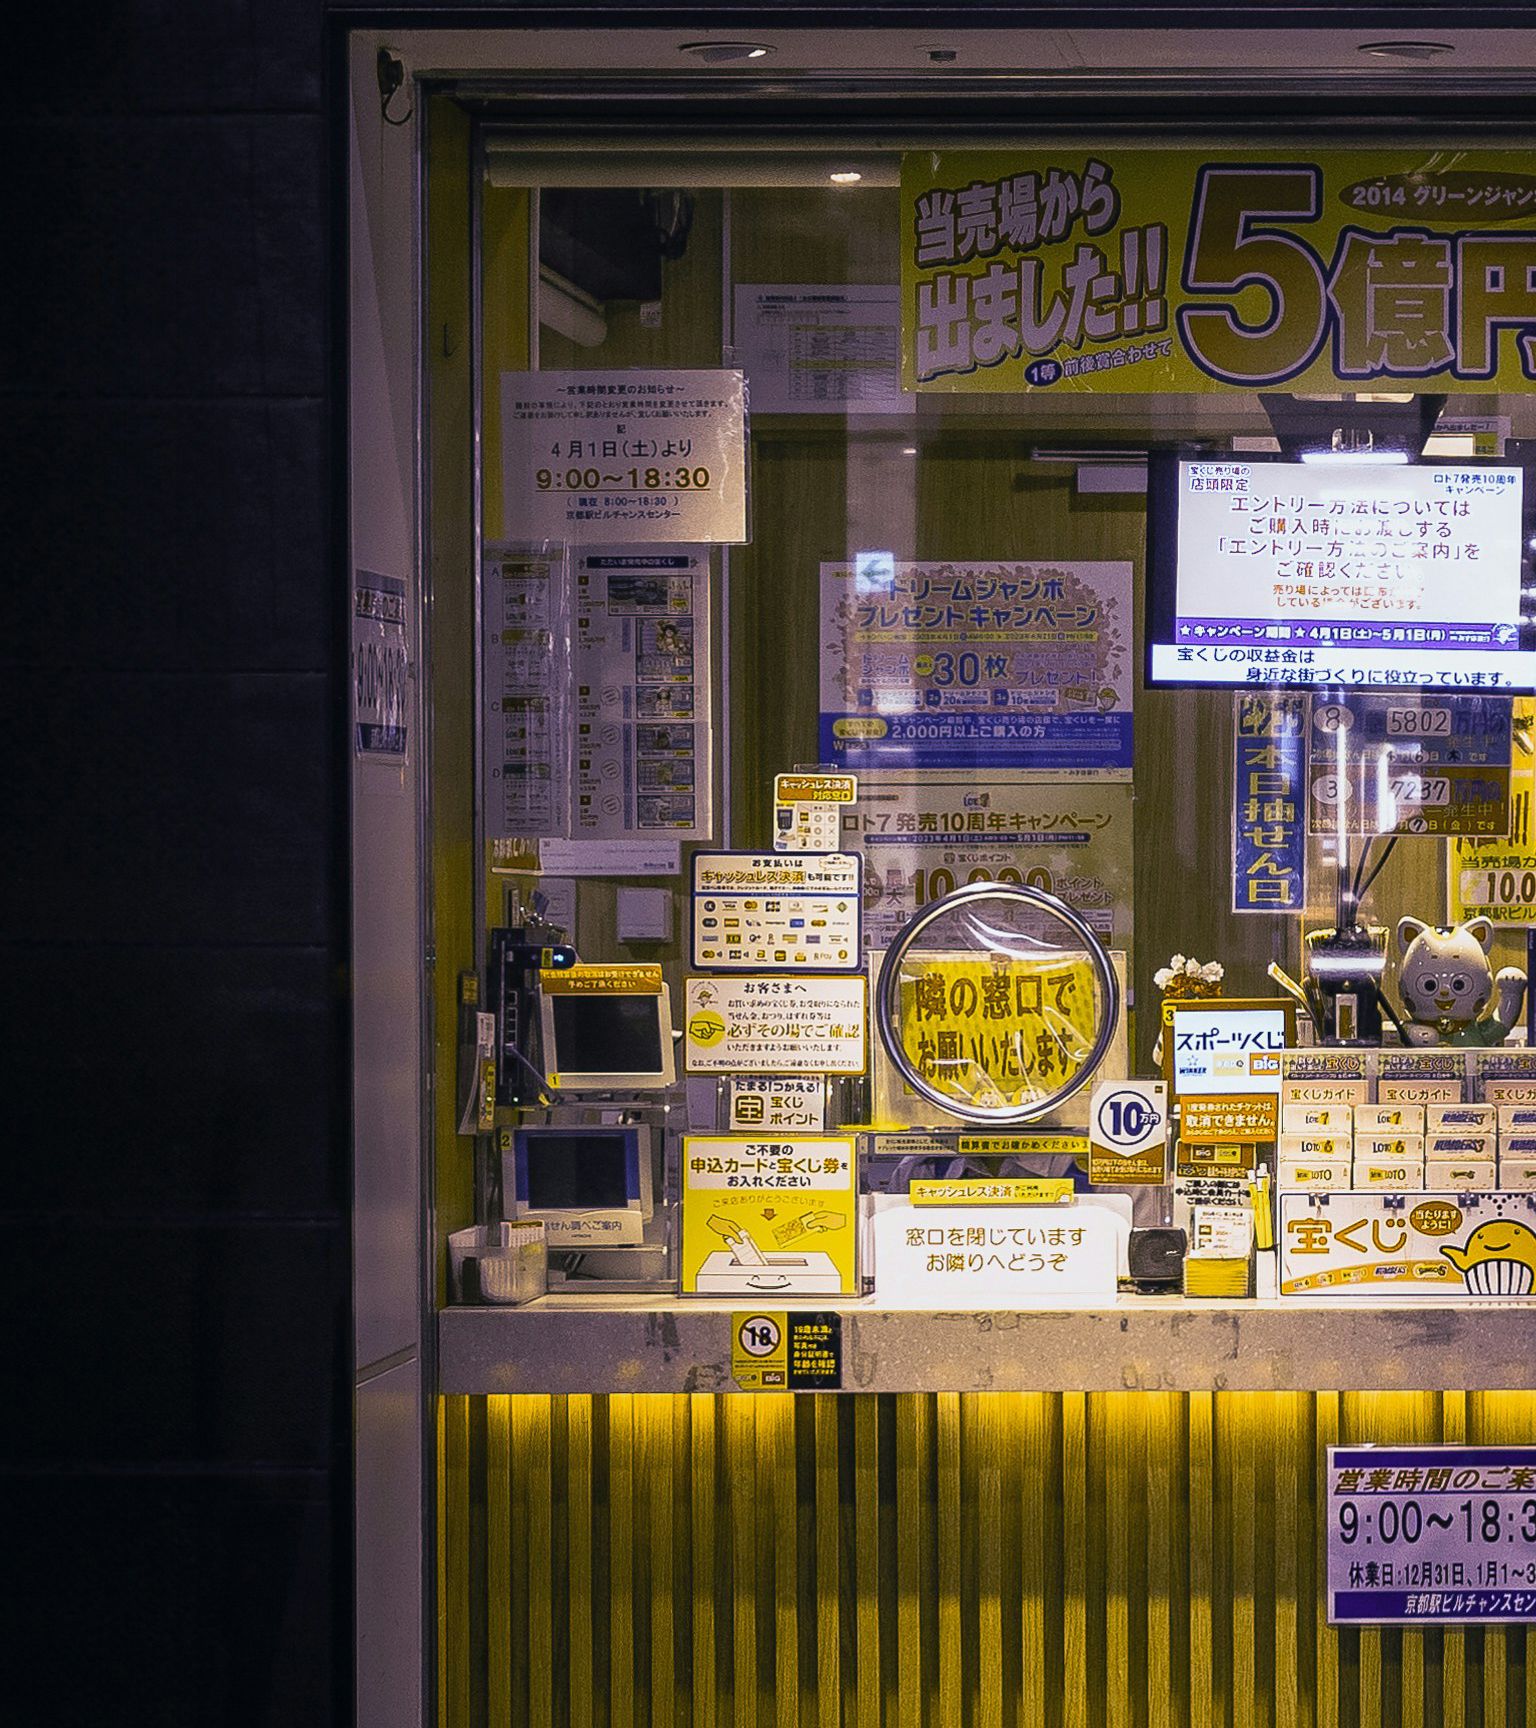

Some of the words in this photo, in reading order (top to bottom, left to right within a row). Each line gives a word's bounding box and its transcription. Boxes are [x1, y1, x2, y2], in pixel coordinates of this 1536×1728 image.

[1352, 186, 1406, 206] 2014
[915, 162, 1120, 268] 当売場から
[915, 226, 1167, 380] 出ました!!
[616, 424, 626, 434] 記
[1189, 478, 1249, 492] 店頭限定
[1444, 485, 1506, 496] キャンペーン
[1231, 496, 1471, 516] エントリー方法については
[566, 510, 681, 520] 京都駅ビルチャンスセンター
[1177, 647, 1316, 664] 宝くじの収益金は
[1391, 709, 1448, 733] 5802
[780, 779, 852, 790] キャッシュレス決済
[743, 982, 807, 994] お客さまへ
[914, 973, 1077, 1022] 隣の窓口で
[727, 1024, 860, 1038] 必ずその場でご確認
[1176, 1028, 1286, 1051] スポーツくじ
[1290, 1088, 1356, 1101] 宝くじガイド
[1386, 1088, 1452, 1101] 宝くじガイド
[769, 1096, 804, 1108] 宝くじ
[769, 1113, 819, 1126] ポイント
[744, 1144, 794, 1156] ご不要の
[690, 1157, 849, 1174] 申込カードと宝くじ券を
[727, 1175, 811, 1188] お入れください
[917, 1186, 1013, 1198] キャッシュレス決済
[905, 1227, 1087, 1247] 窓口を閉じています
[1287, 1217, 1407, 1254] 宝くじ
[926, 1253, 1069, 1273] お隣りへどうぞ
[750, 1326, 772, 1347] 18
